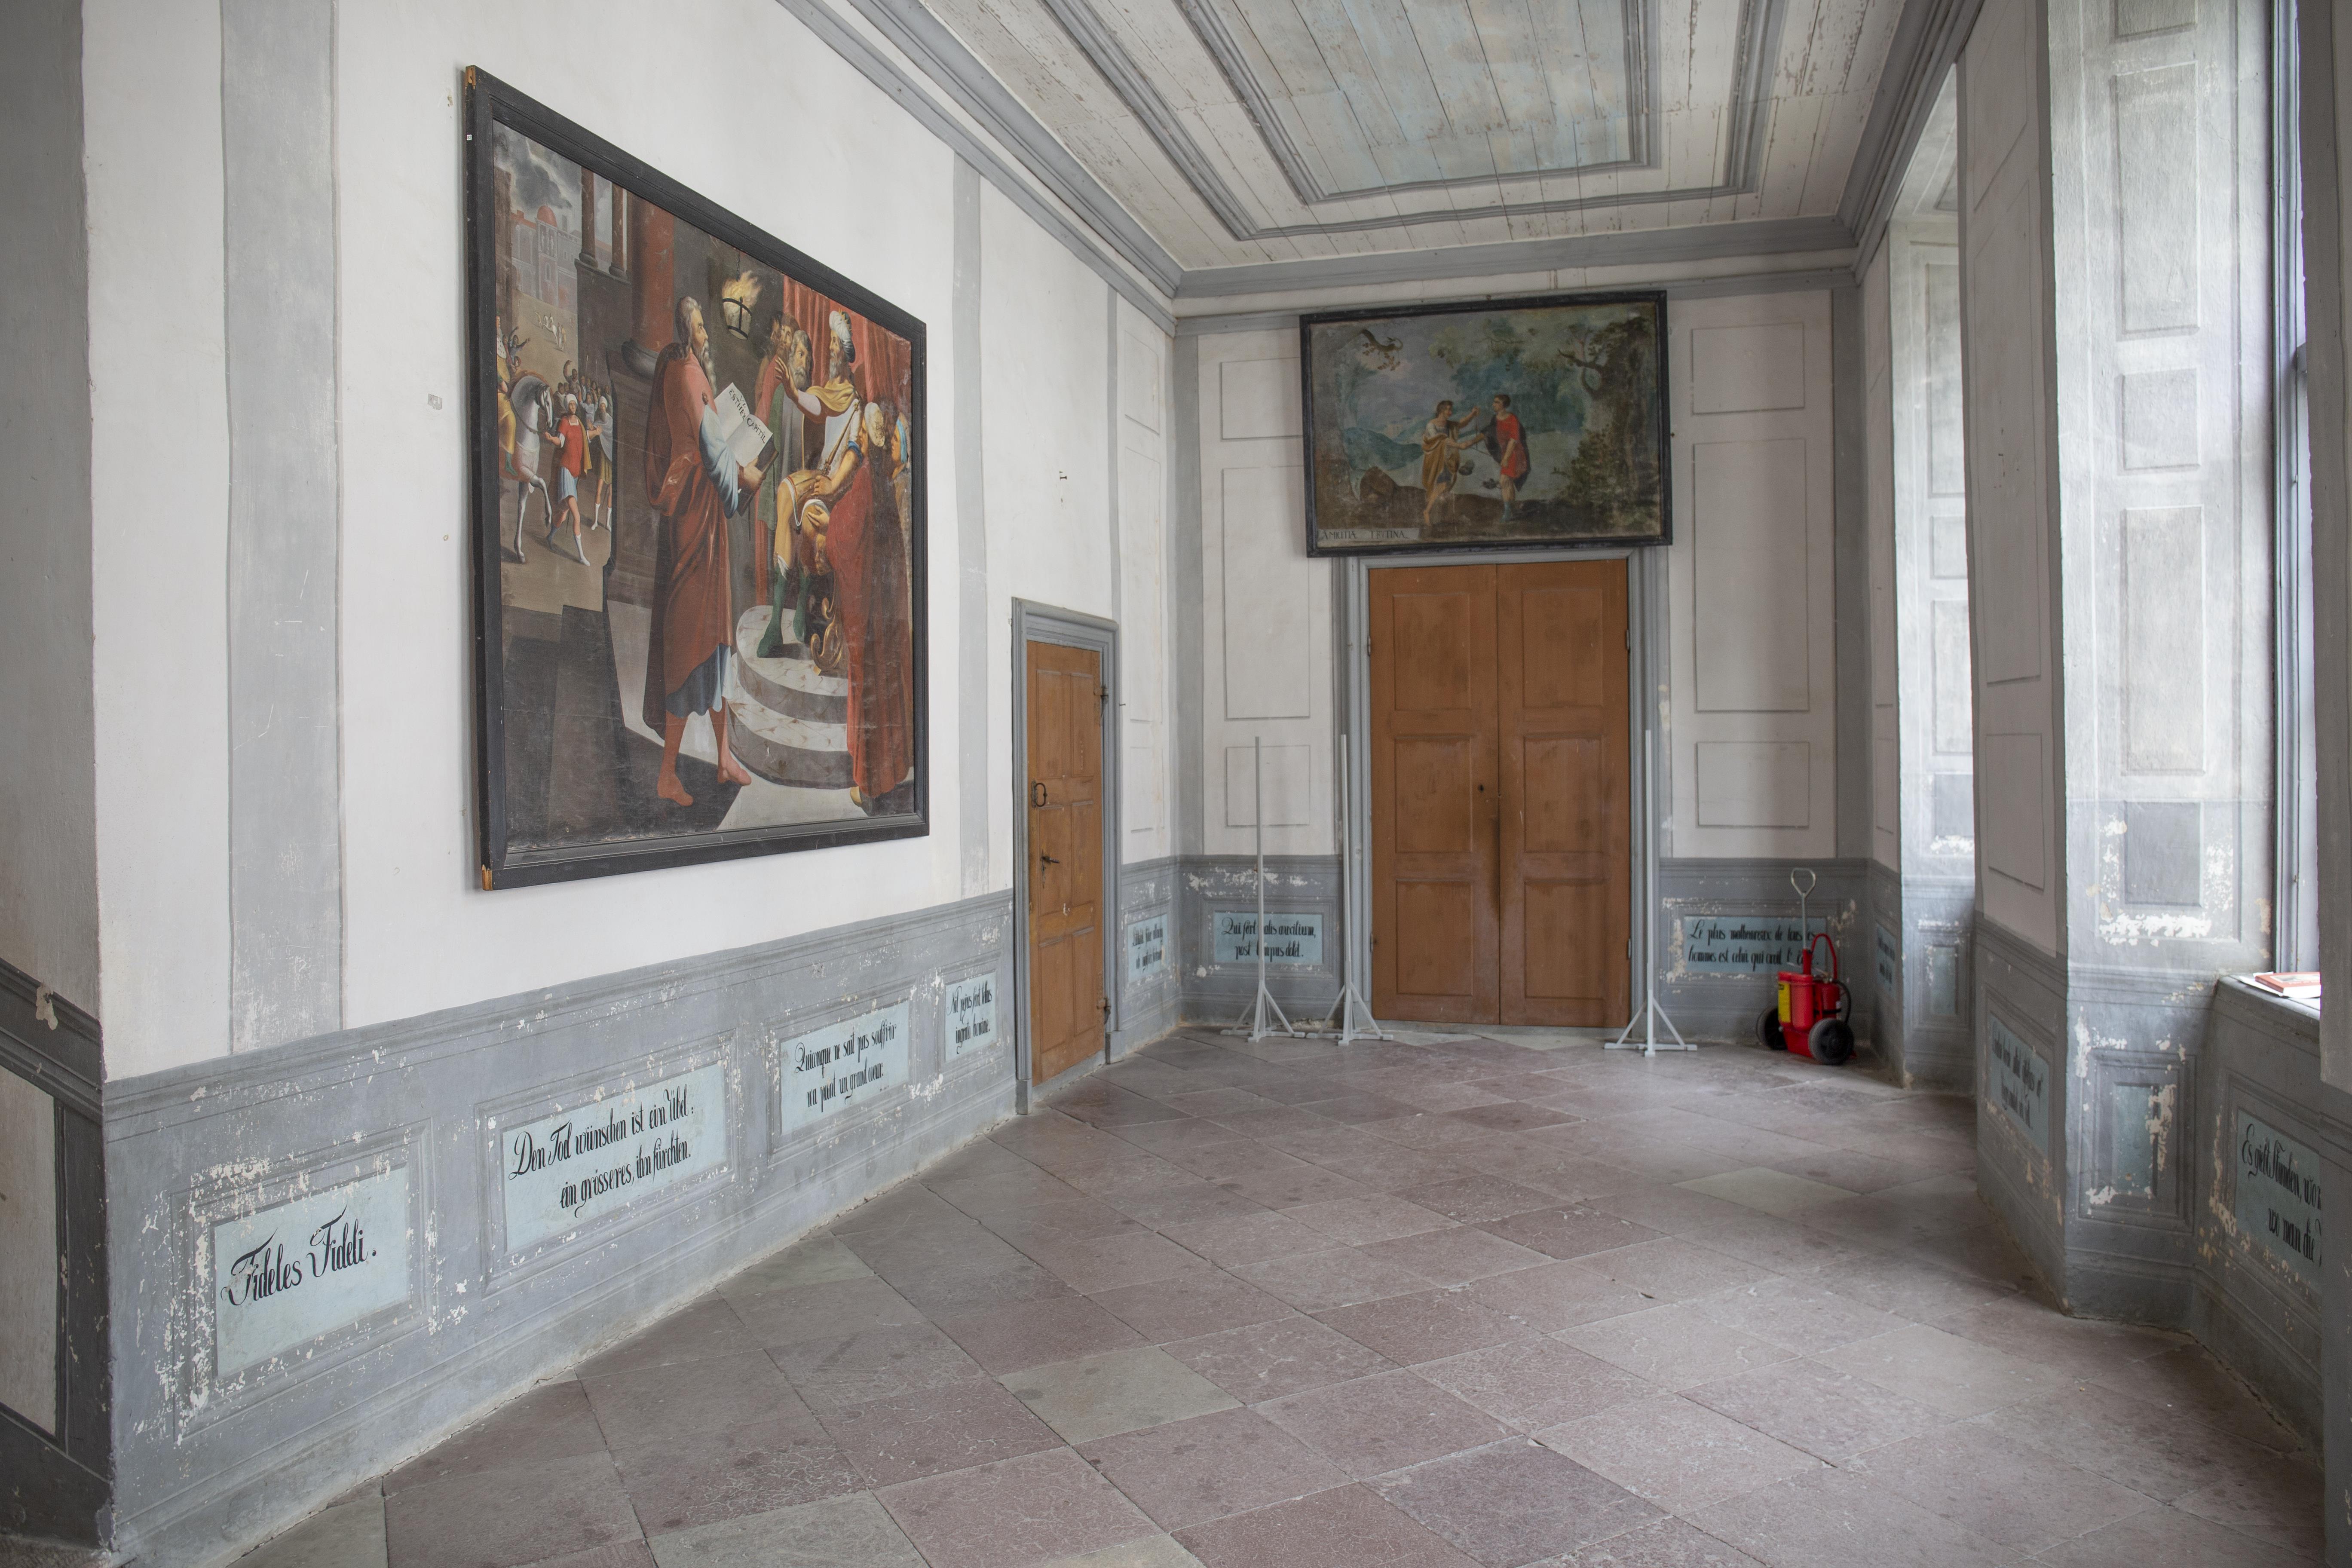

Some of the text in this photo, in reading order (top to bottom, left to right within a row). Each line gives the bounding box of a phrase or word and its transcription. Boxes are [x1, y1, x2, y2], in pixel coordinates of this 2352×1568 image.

[729, 389, 746, 420] ESTHER
[1221, 917, 1241, 935] Qui
[1259, 919, 1277, 935] alis
[1234, 940, 1251, 960] post
[1687, 919, 1705, 939] Le
[1708, 922, 1726, 946] plus
[1775, 924, 1782, 941] de
[1688, 944, 1716, 962] hommes
[1718, 947, 1728, 963] est
[1732, 946, 1749, 962] celui
[1751, 949, 1764, 972] qui
[794, 1019, 897, 1078] Quiconque ne sait pas souffrir
[807, 1087, 818, 1107] n'a
[820, 1070, 836, 1112] point
[839, 1075, 848, 1094] un
[845, 1057, 867, 1104] grand
[508, 1131, 546, 1180] Den
[548, 1119, 572, 1165] Tod
[576, 1108, 628, 1154] wünschen
[631, 1102, 644, 1135] ist
[649, 1105, 667, 1129] ein
[2242, 1123, 2254, 1166] Es
[560, 1131, 691, 1218] ein grösseres, ihn fürchten.
[2269, 1208, 2280, 1237] wo
[2283, 1217, 2301, 1253] man
[2303, 1217, 2315, 1262] die
[221, 1228, 301, 1305] Fideles
